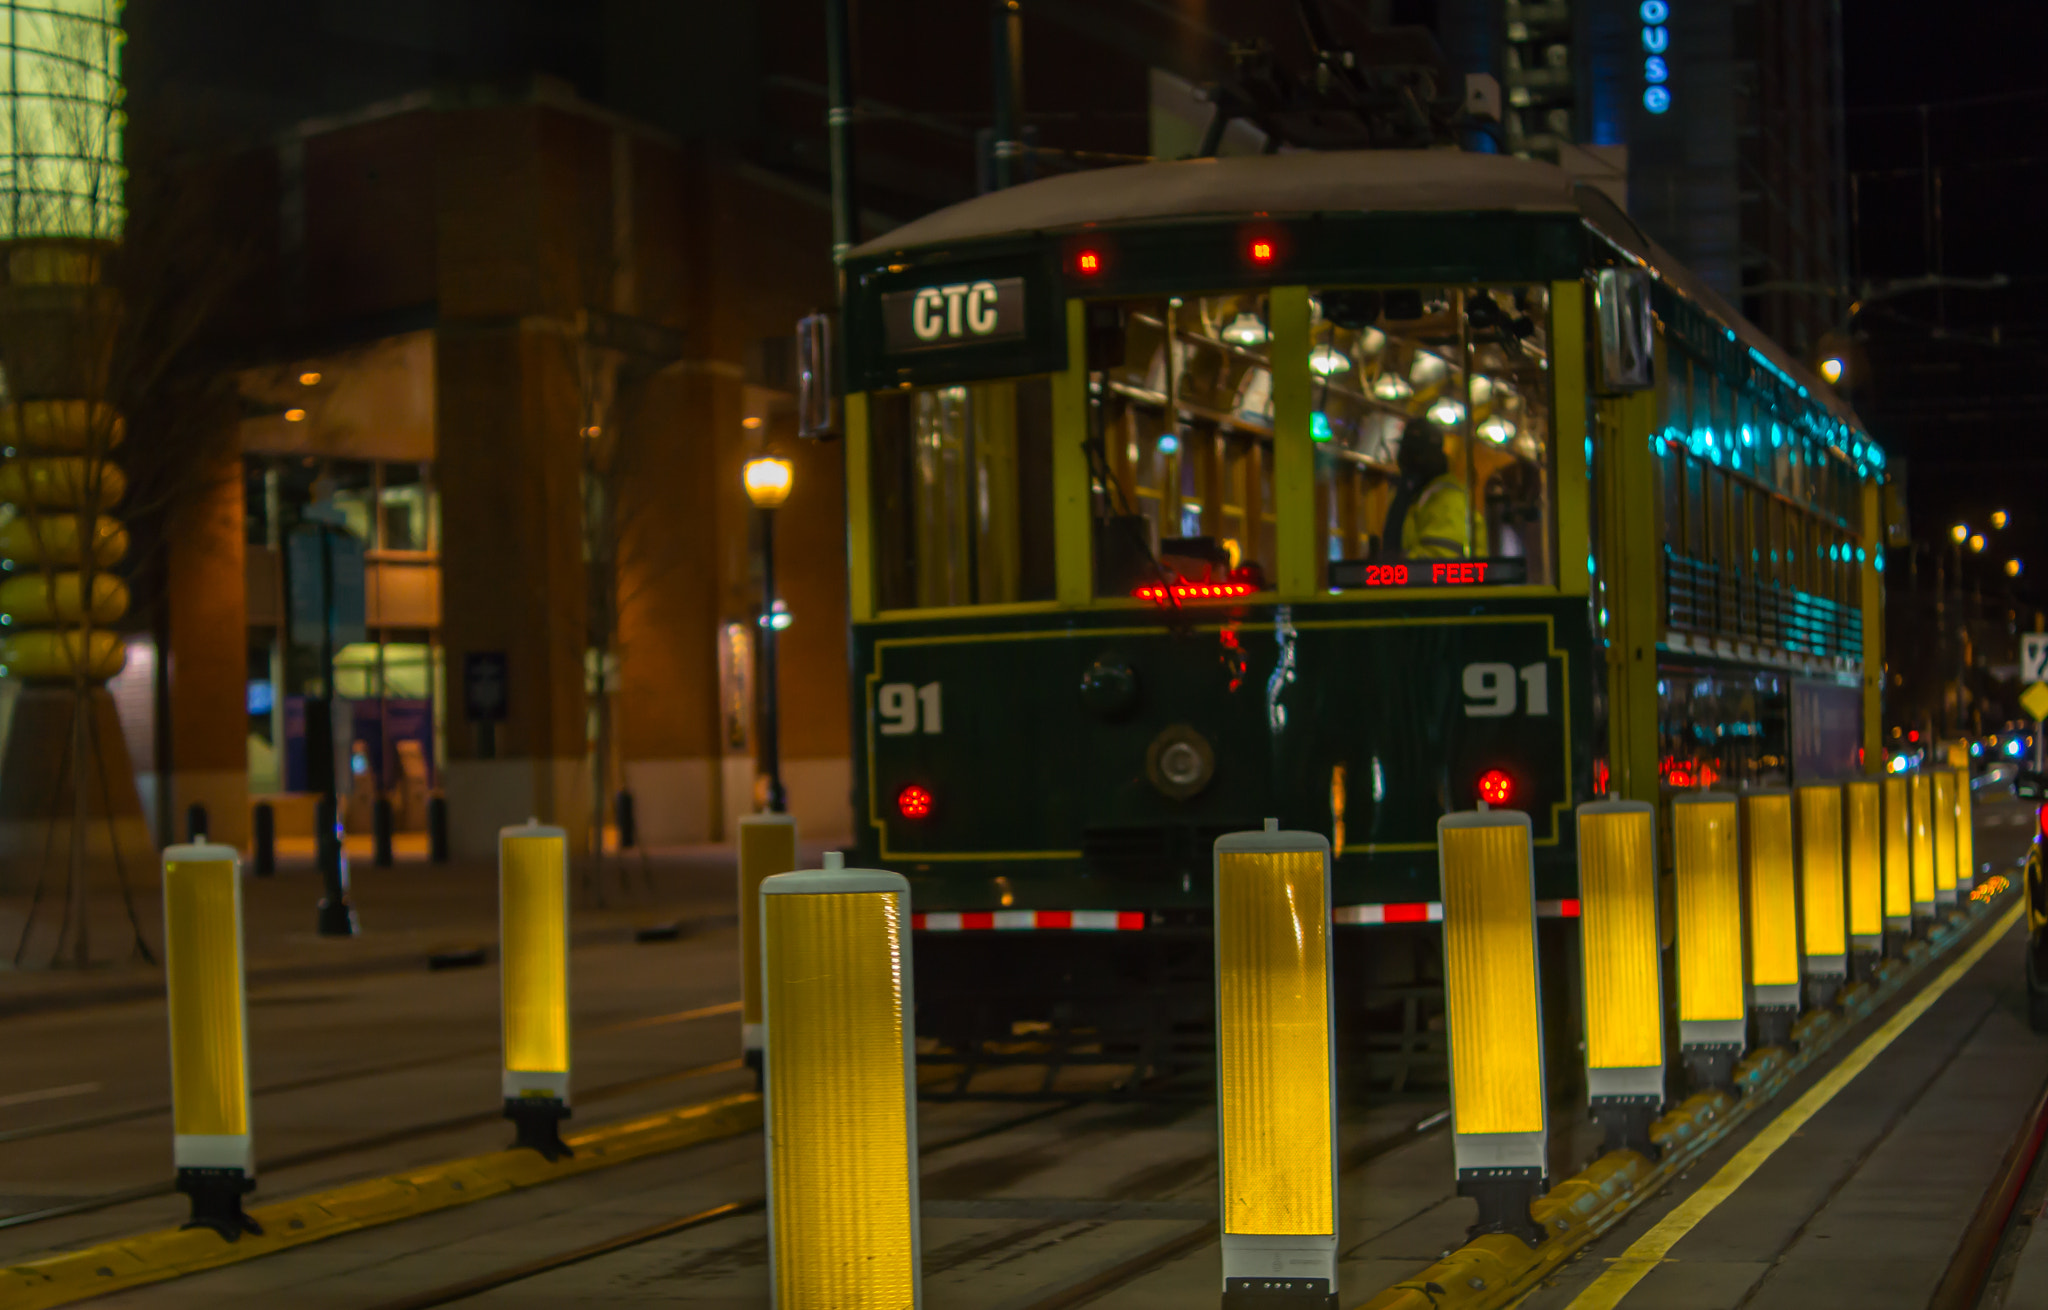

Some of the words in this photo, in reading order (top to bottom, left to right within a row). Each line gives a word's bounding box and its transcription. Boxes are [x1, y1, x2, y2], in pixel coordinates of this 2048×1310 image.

[912, 280, 998, 340] CTC
[1366, 564, 1408, 585] 200
[1432, 562, 1488, 584] FEET
[879, 681, 942, 735] 91
[1462, 662, 1548, 717] 91
